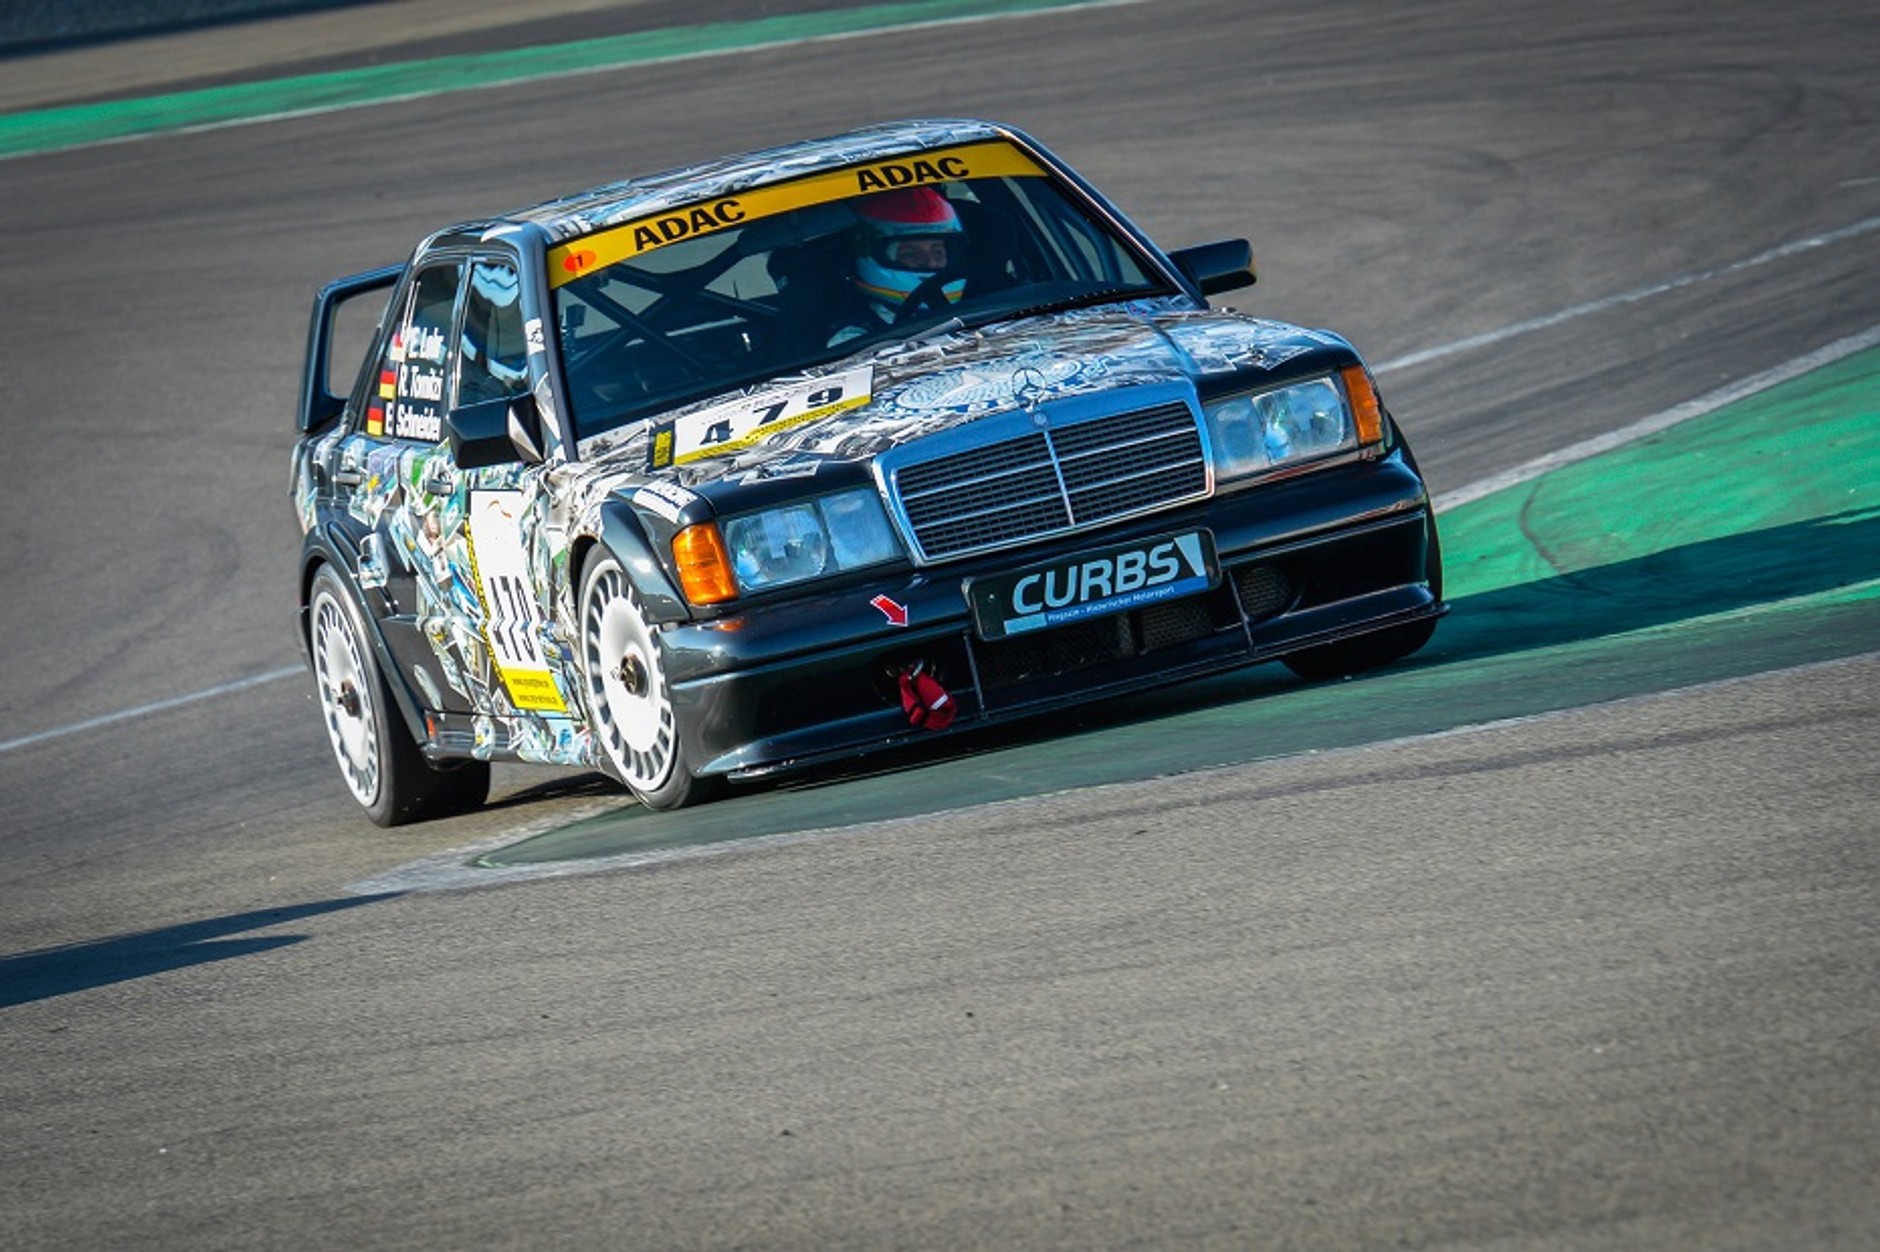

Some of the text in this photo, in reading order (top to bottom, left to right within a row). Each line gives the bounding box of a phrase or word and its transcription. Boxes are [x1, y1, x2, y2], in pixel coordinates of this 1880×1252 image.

[856, 156, 970, 192] ADAC
[633, 199, 746, 252] ADAC
[1012, 541, 1181, 615] CURBS
